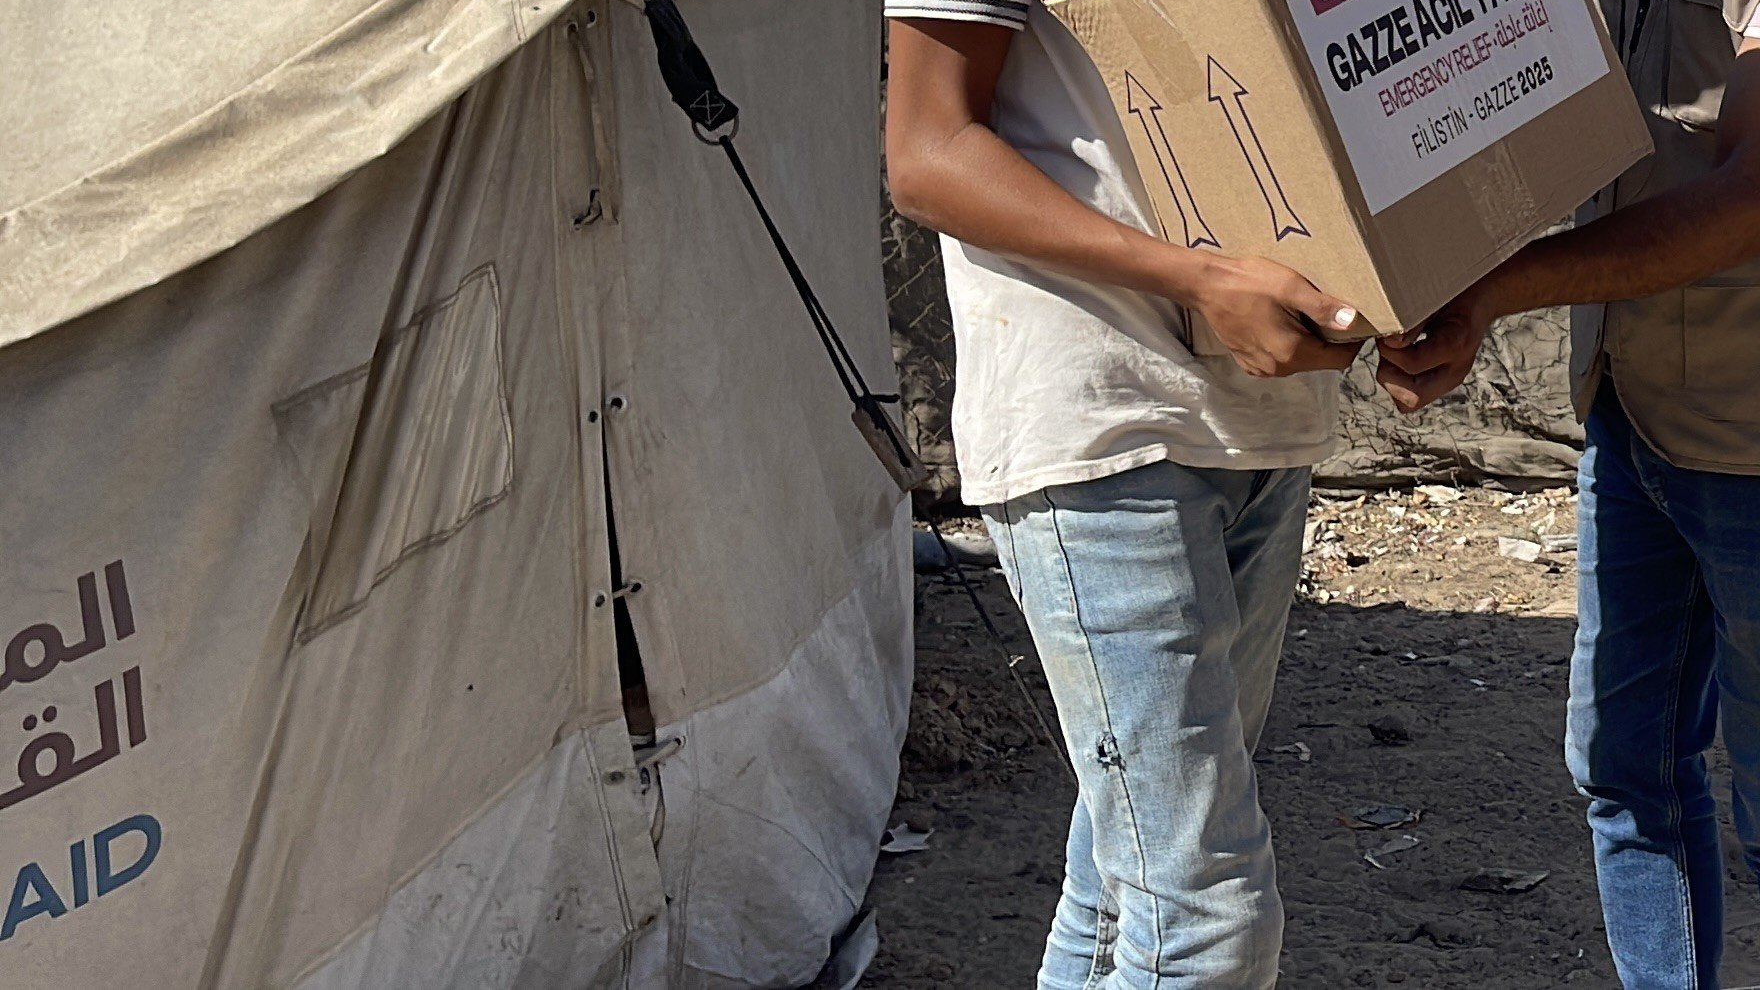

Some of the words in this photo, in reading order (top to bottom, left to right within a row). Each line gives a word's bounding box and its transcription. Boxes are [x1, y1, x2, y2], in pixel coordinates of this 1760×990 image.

[1326, 5, 1421, 91] GAZZE
[1378, 53, 1455, 117] EMERGENCY
[1452, 31, 1492, 75] RELIEF
[1494, 13, 1526, 50] عاجلة
[1411, 106, 1469, 159] FİLİSTİN
[1473, 76, 1520, 121] GAZZE
[1517, 56, 1554, 96] 2025
[0, 558, 136, 692] الم
[0, 665, 147, 810] الق
[0, 813, 162, 941] AID
